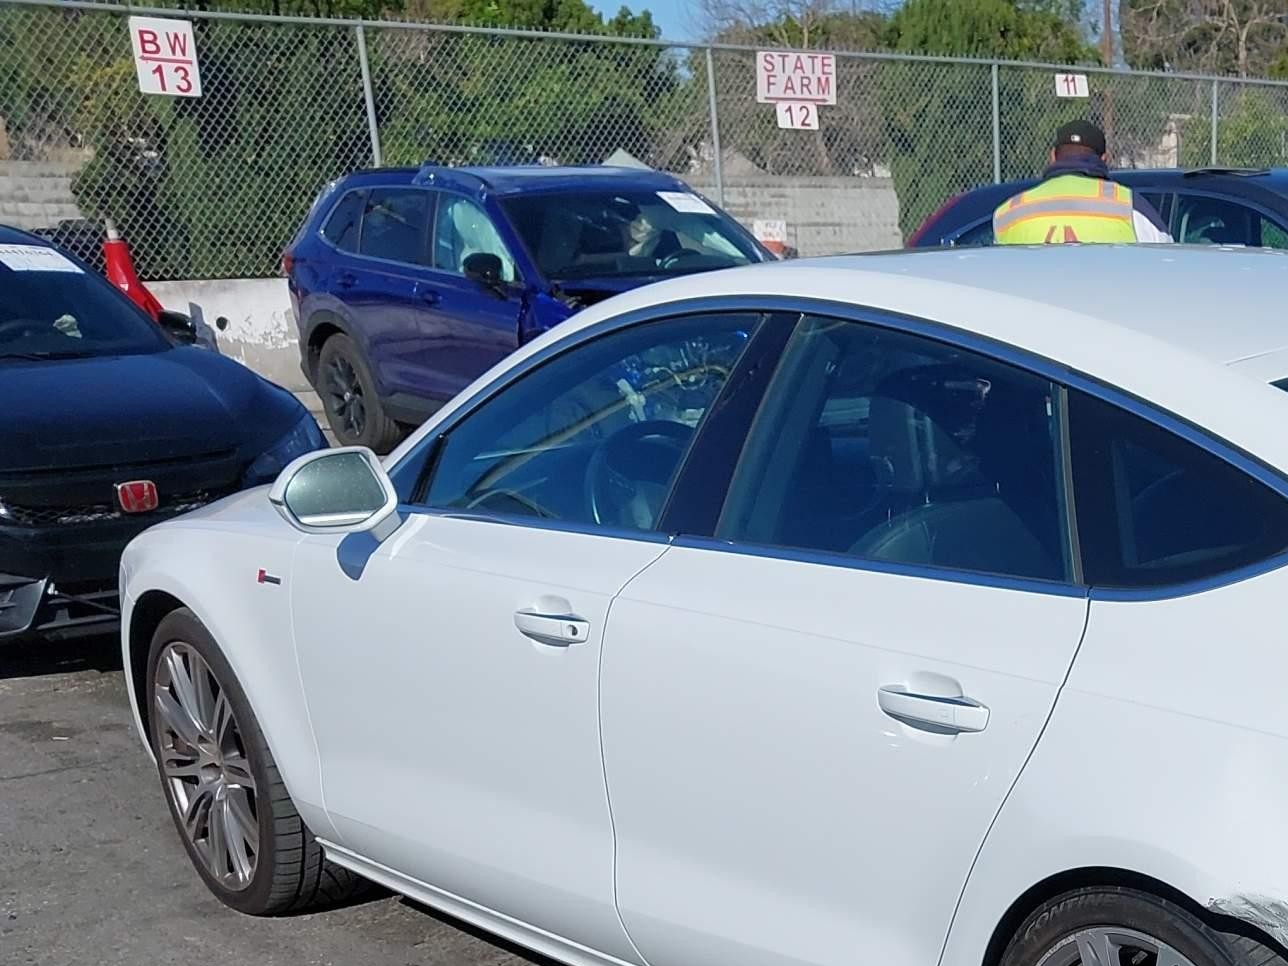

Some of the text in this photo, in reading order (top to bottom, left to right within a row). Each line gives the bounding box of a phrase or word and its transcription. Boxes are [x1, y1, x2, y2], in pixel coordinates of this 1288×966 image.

[763, 53, 833, 75] STATE
[152, 64, 192, 93] 13
[766, 75, 831, 95] FARM
[1063, 75, 1078, 95] 11
[785, 105, 812, 127] 12
